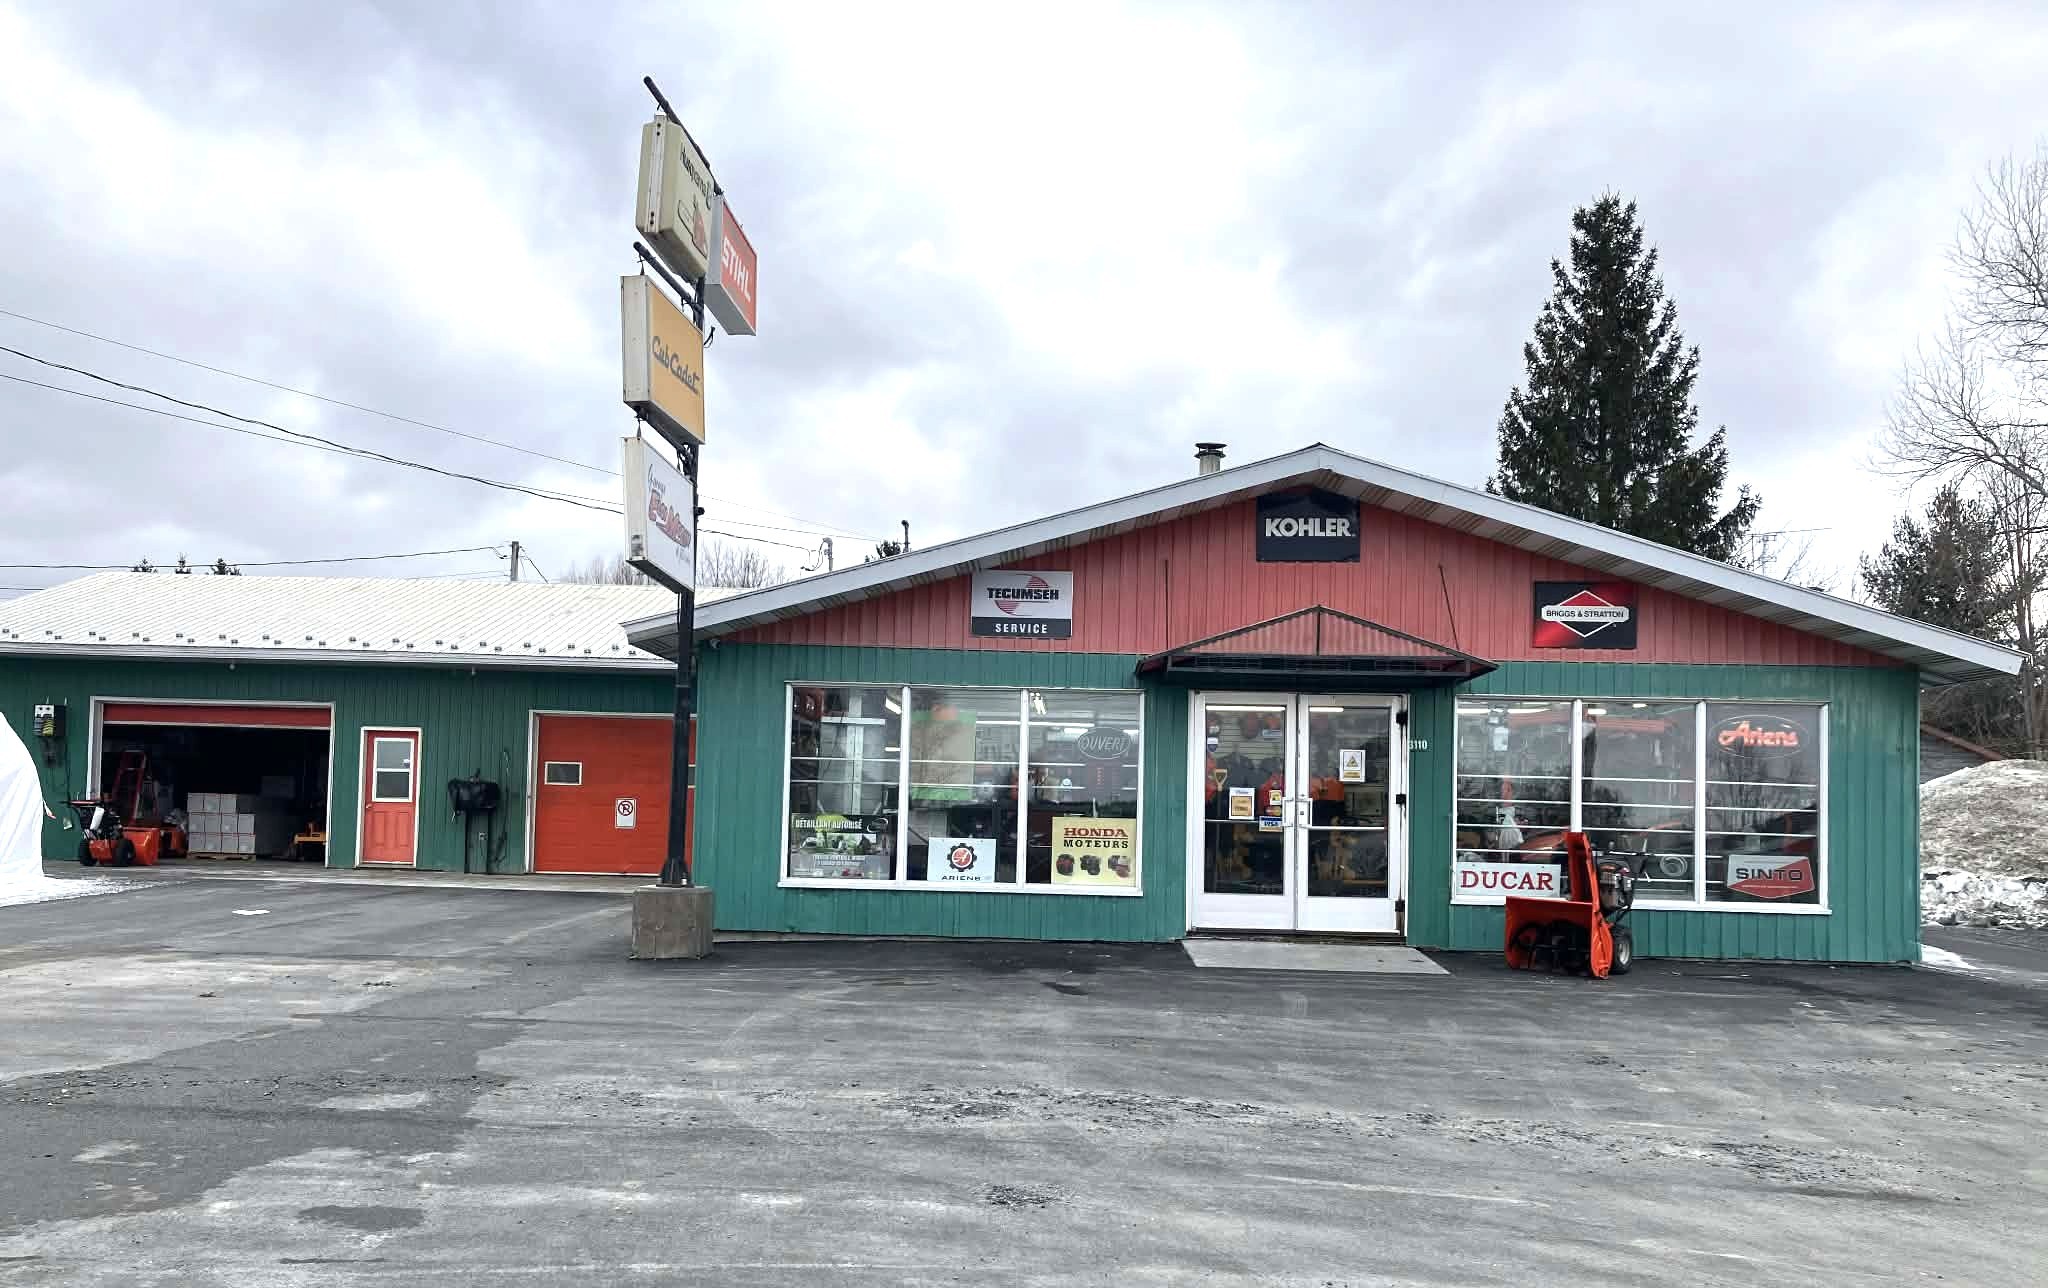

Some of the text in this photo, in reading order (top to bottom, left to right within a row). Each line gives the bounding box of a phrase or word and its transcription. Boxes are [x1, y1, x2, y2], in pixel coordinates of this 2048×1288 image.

[721, 236, 752, 302] STIHL
[651, 335, 701, 396] Cub Cadet
[1265, 517, 1352, 537] KOHLER
[987, 587, 1060, 600] TECUMSEH
[1546, 610, 1576, 618] BRIGGS
[1584, 610, 1625, 618] STRATTON
[995, 623, 1048, 634] SERVICE
[1718, 720, 1799, 746] Ariens
[1080, 735, 1129, 751] OUVERT
[1063, 827, 1129, 838] HONDA
[1063, 839, 1129, 849] MOTEURS
[1461, 870, 1554, 891] DUCAR
[1735, 868, 1803, 881] SINTO
